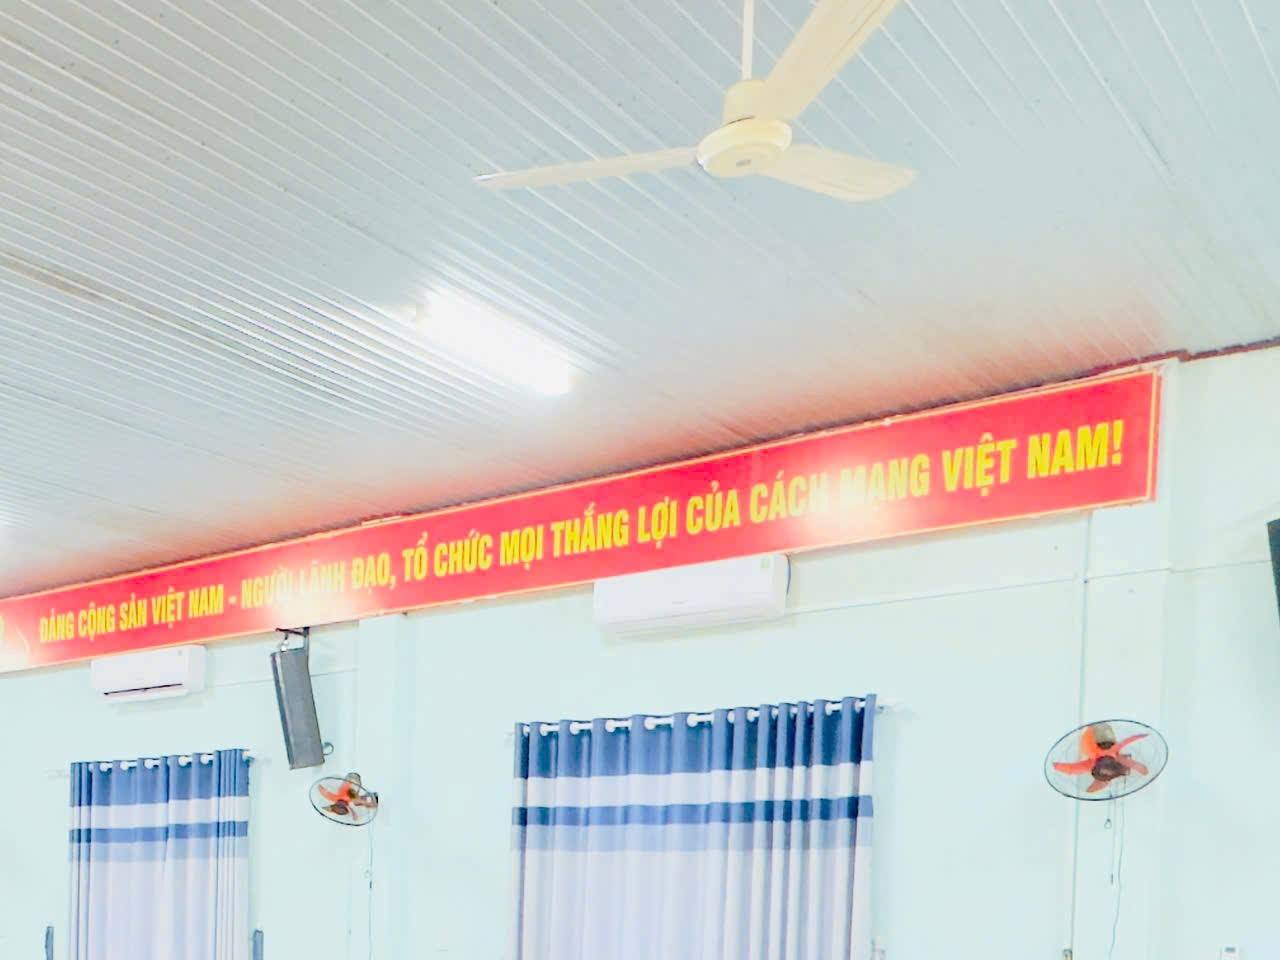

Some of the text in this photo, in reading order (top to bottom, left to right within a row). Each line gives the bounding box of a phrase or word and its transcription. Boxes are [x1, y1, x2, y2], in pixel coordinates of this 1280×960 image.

[78, 601, 115, 641] CỘNG
[119, 592, 148, 631] SẢN
[151, 587, 185, 629] VIỆT
[188, 584, 224, 618] NAM
[351, 552, 396, 594] ĐẠO,
[402, 531, 429, 582] TỔ
[433, 529, 493, 577] CHỨC
[499, 525, 544, 571] MỌI
[550, 502, 630, 558] THẮNG
[637, 496, 678, 549] LỢI
[685, 480, 741, 536] CỦA
[749, 470, 828, 524] CÁCH
[941, 432, 1017, 497] VIỆT
[1027, 420, 1124, 480] NAM!
